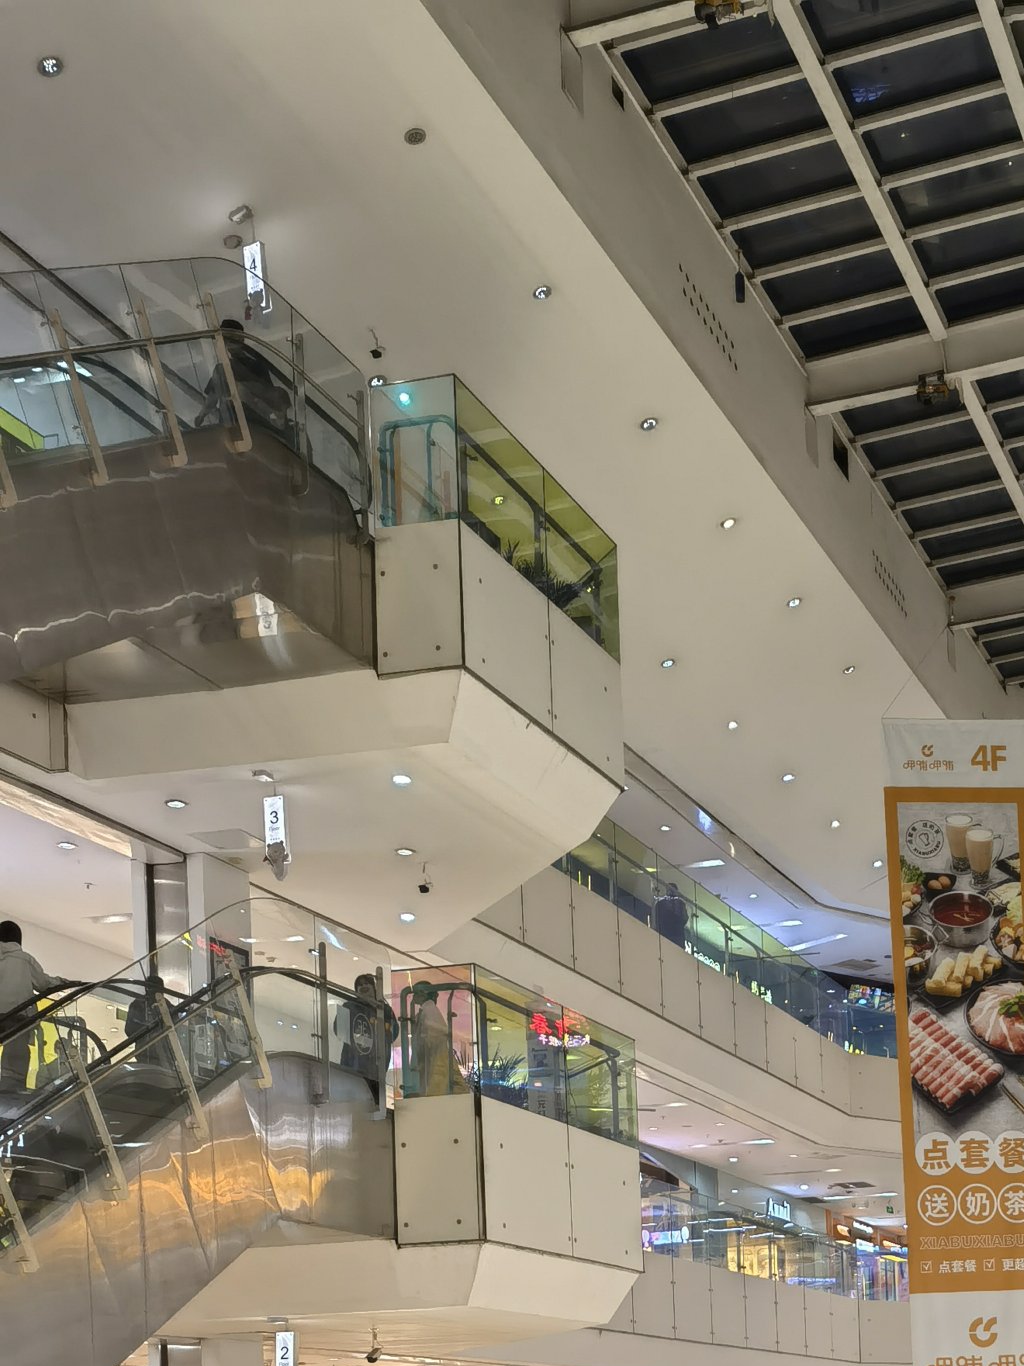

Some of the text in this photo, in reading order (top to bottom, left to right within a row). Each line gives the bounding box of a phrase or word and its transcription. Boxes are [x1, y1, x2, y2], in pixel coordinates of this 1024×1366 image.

[250, 258, 257, 271] 4
[971, 745, 1007, 771] 4F
[270, 811, 279, 824] 3
[938, 1259, 977, 1274] 点套餐
[280, 1346, 289, 1360] 2
